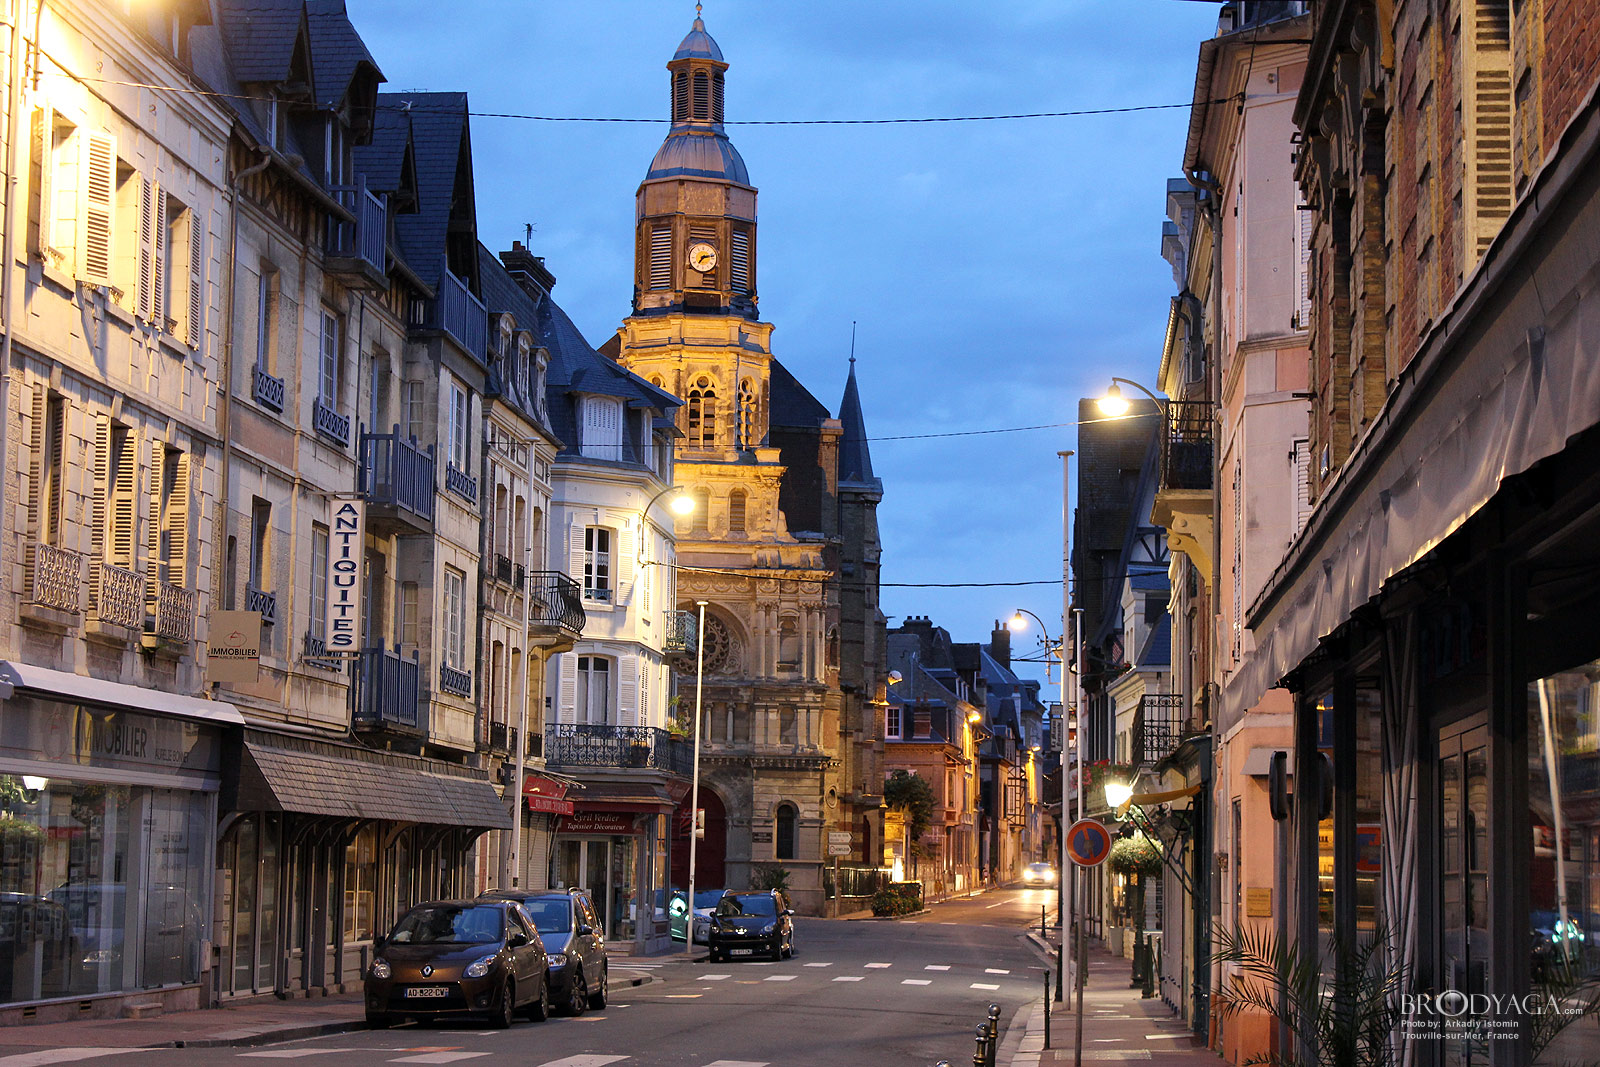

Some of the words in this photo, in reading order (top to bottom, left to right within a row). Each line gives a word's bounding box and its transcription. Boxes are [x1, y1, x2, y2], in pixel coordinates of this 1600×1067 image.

[331, 503, 359, 646] ANTIQUITES
[211, 648, 257, 656] IMMOBILIER
[574, 814, 592, 823] Cyril
[594, 813, 620, 822] Verdier
[567, 823, 592, 831] Tapissier
[594, 823, 626, 831] Décorateur
